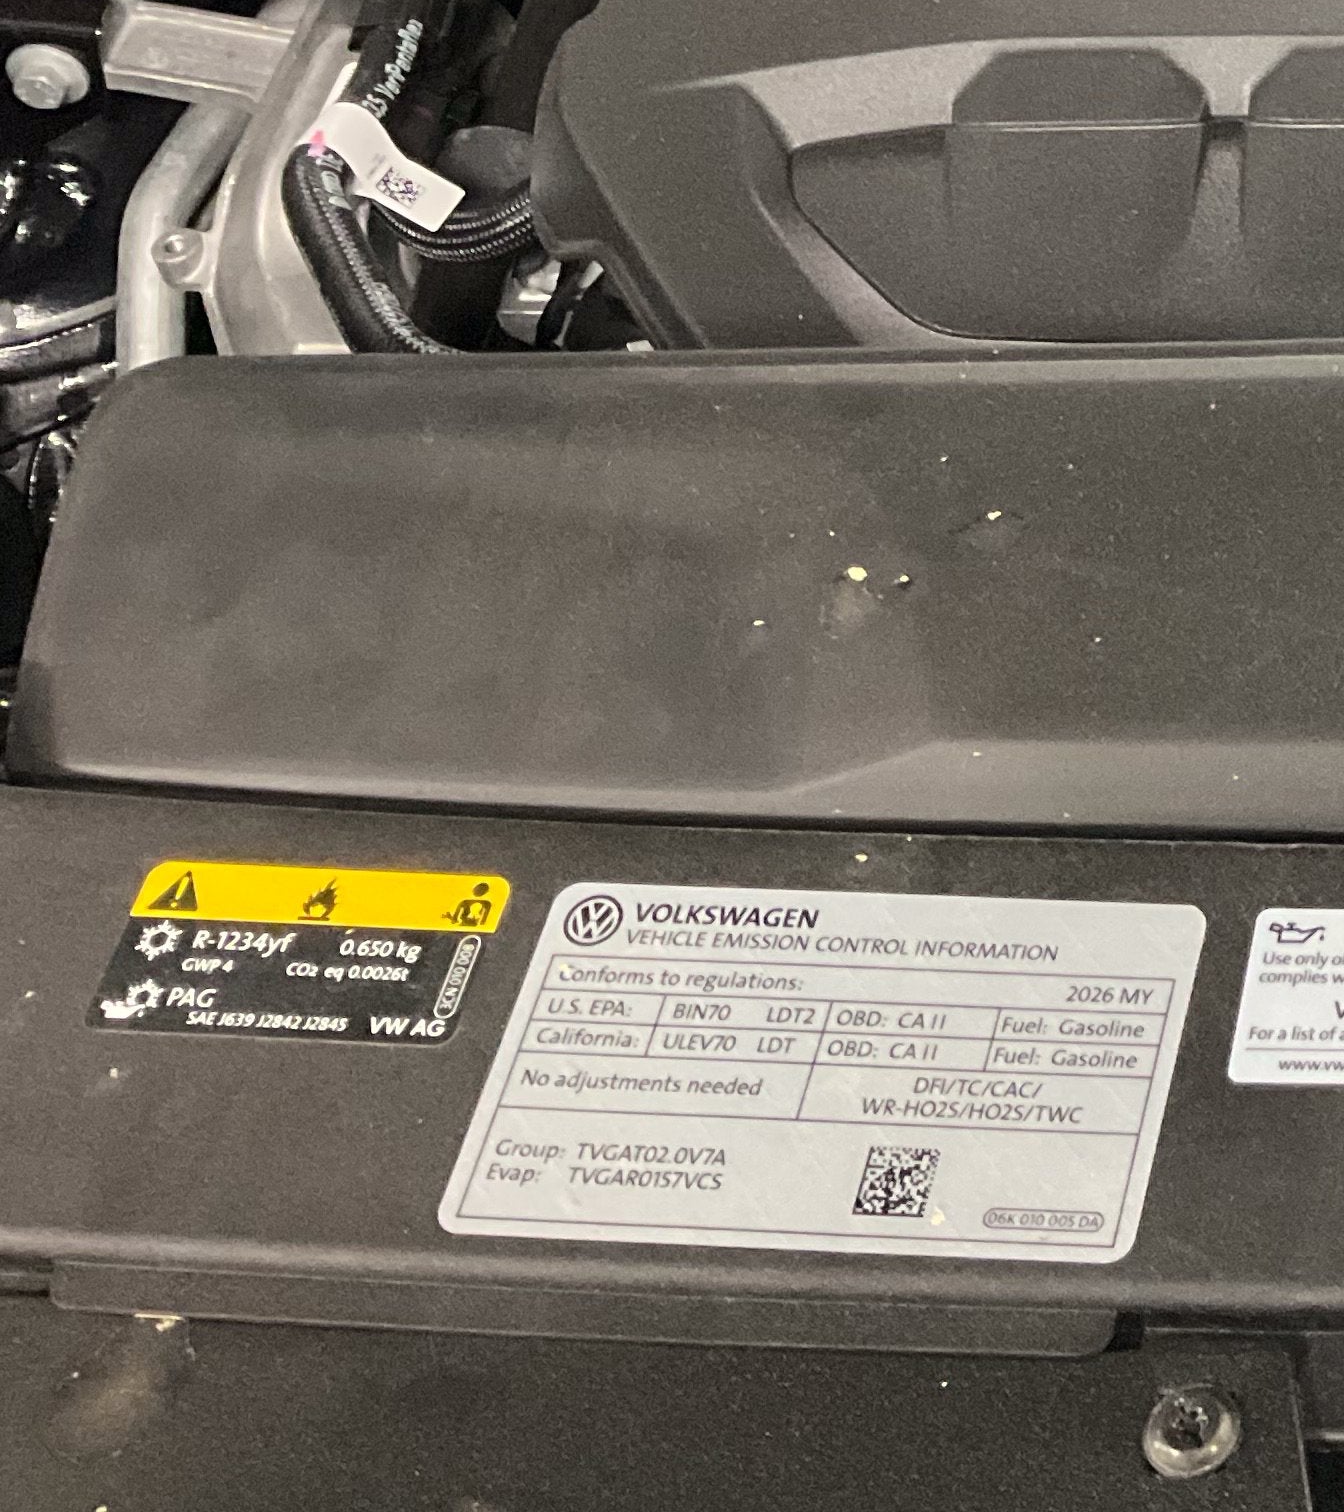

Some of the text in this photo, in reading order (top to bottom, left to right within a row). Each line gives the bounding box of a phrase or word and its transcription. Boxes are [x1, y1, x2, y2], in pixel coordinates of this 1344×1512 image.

[636, 902, 820, 928] VOLKSWAGEN
[192, 930, 422, 963] R-1234yf 0.650 kg
[626, 929, 1059, 961] VEHICLE EMISSION CONTROL INFORMATION
[181, 957, 409, 982] GWP 0.0026t
[1263, 952, 1291, 966] Use
[1295, 953, 1329, 970] only
[558, 963, 804, 992] Conforms to regulations:
[1258, 970, 1328, 987] complies
[166, 988, 216, 1007] PAG
[1066, 986, 1154, 1005] 2026 MY
[548, 999, 632, 1016] U.S. EPA:
[673, 1003, 816, 1024] BIN70 LDT2
[186, 1011, 349, 1031] SAE J639 J2842 J2845
[370, 1016, 446, 1037] VW AG
[836, 1010, 888, 1028] OBD:
[1001, 1017, 1145, 1039] Fuel: Gasoline
[536, 1028, 640, 1048] California:
[663, 1032, 797, 1054] ULEV70 LDT
[1250, 1026, 1274, 1040] For
[1291, 1027, 1315, 1041] list
[827, 1040, 879, 1058] OBD:
[993, 1048, 1138, 1070] Fuel: Gasoline
[520, 1069, 764, 1096] No adjustments needed
[913, 1076, 1043, 1099] DFI/TC/CAC/
[862, 1098, 1084, 1124] WR-HO2S/HO2S/TWC
[496, 1139, 727, 1165] Group: TVGAT02.0V7A
[486, 1162, 723, 1190] Evap: TVGAR0157VCS
